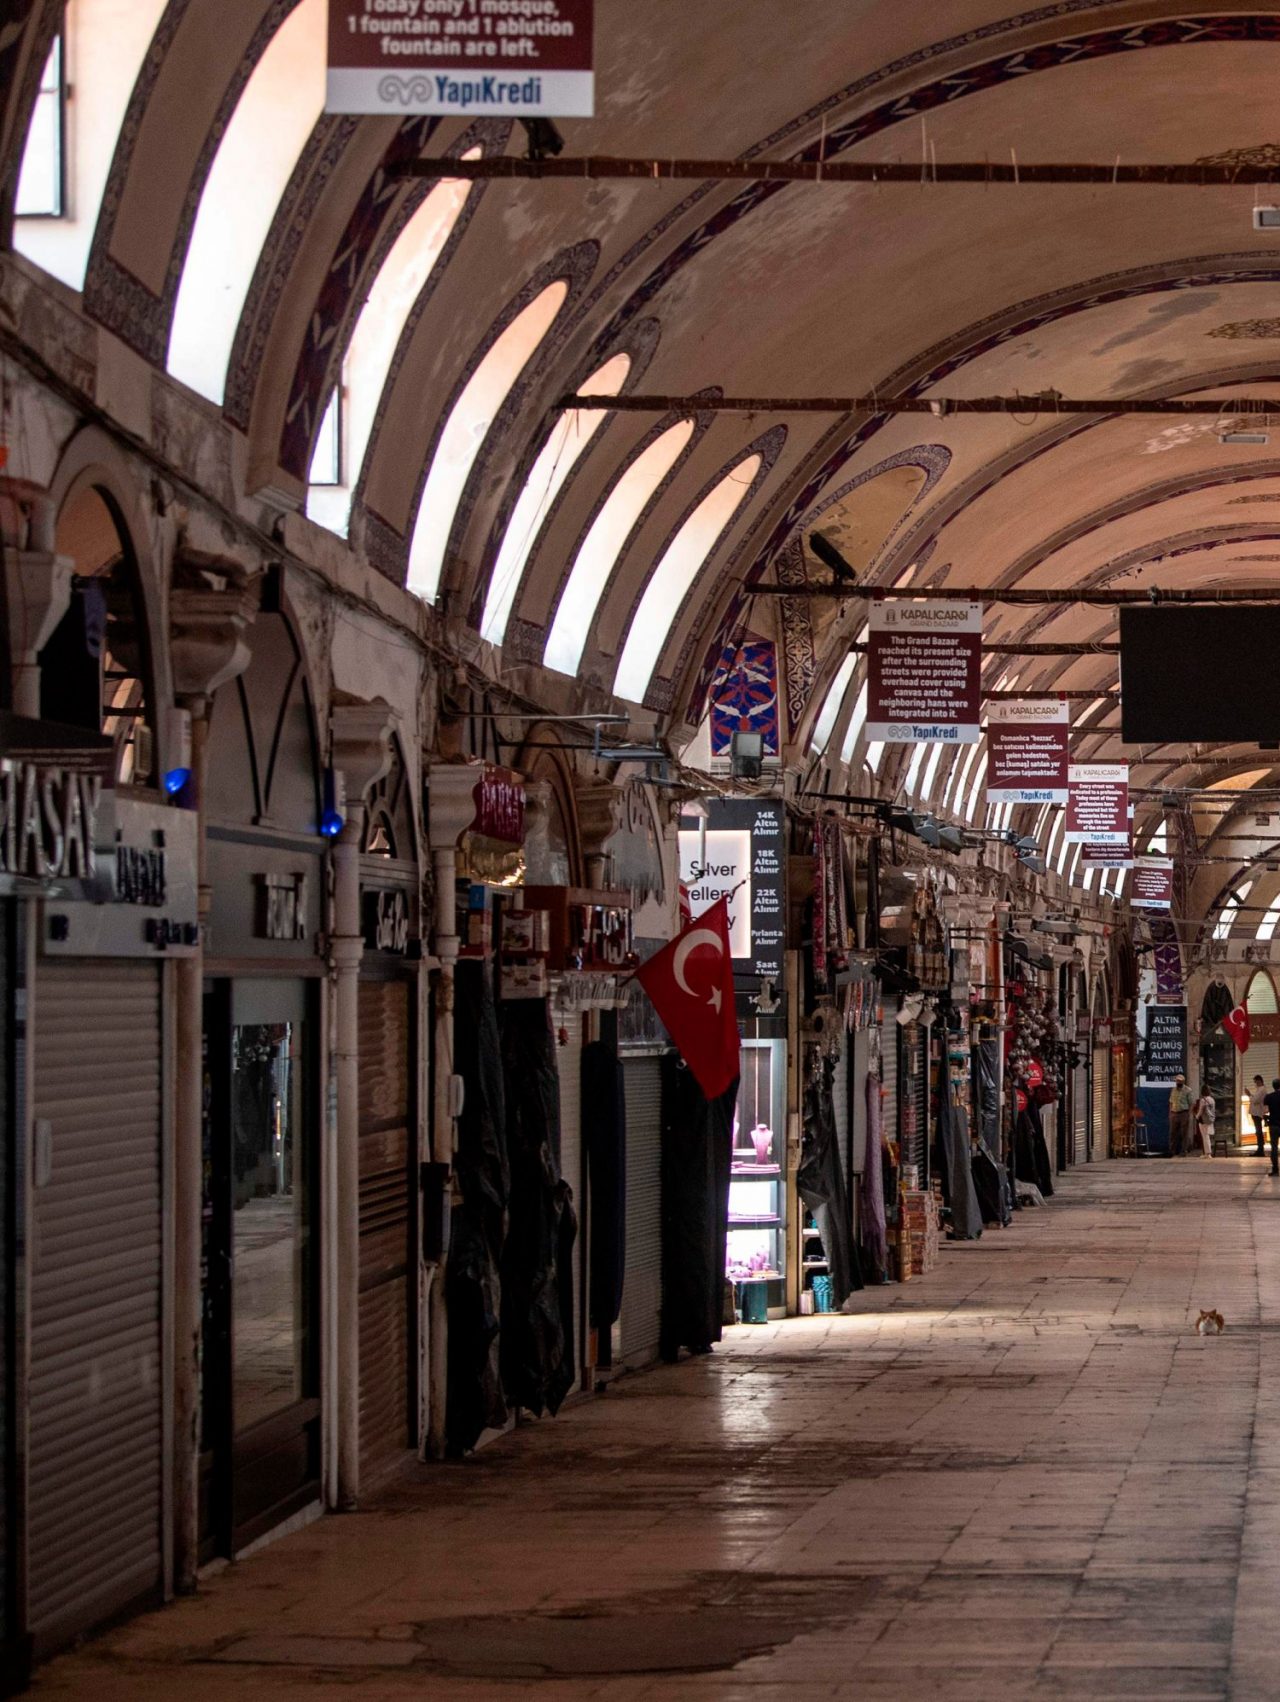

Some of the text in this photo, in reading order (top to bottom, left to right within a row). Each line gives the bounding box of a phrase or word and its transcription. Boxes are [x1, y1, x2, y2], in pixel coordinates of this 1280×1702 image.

[365, 0, 559, 17] Today only 1 mosque,
[349, 16, 574, 36] 1 fountain and 1 ablution
[381, 38, 539, 56] fountain are left.
[436, 77, 541, 107] YapıKredi
[891, 636, 959, 645] The Grand Bazaar
[878, 647, 971, 656] reached its present size
[919, 658, 966, 668] surrounding
[881, 668, 909, 676] streets
[933, 668, 968, 677] provided
[882, 678, 918, 686] overhead
[944, 680, 966, 689] using
[879, 699, 926, 708] neighboring
[889, 709, 930, 718] integrated
[949, 710, 958, 718] it.
[912, 726, 958, 739] YapıKredi
[758, 850, 774, 858] 18K
[755, 858, 779, 866] Altın
[690, 861, 736, 876] Slver
[688, 887, 735, 904] ellery
[754, 897, 779, 905] Altın
[754, 905, 780, 913] Alınır
[751, 929, 783, 937] Pırlanta
[1150, 1041, 1182, 1050] GÜMÜŞ
